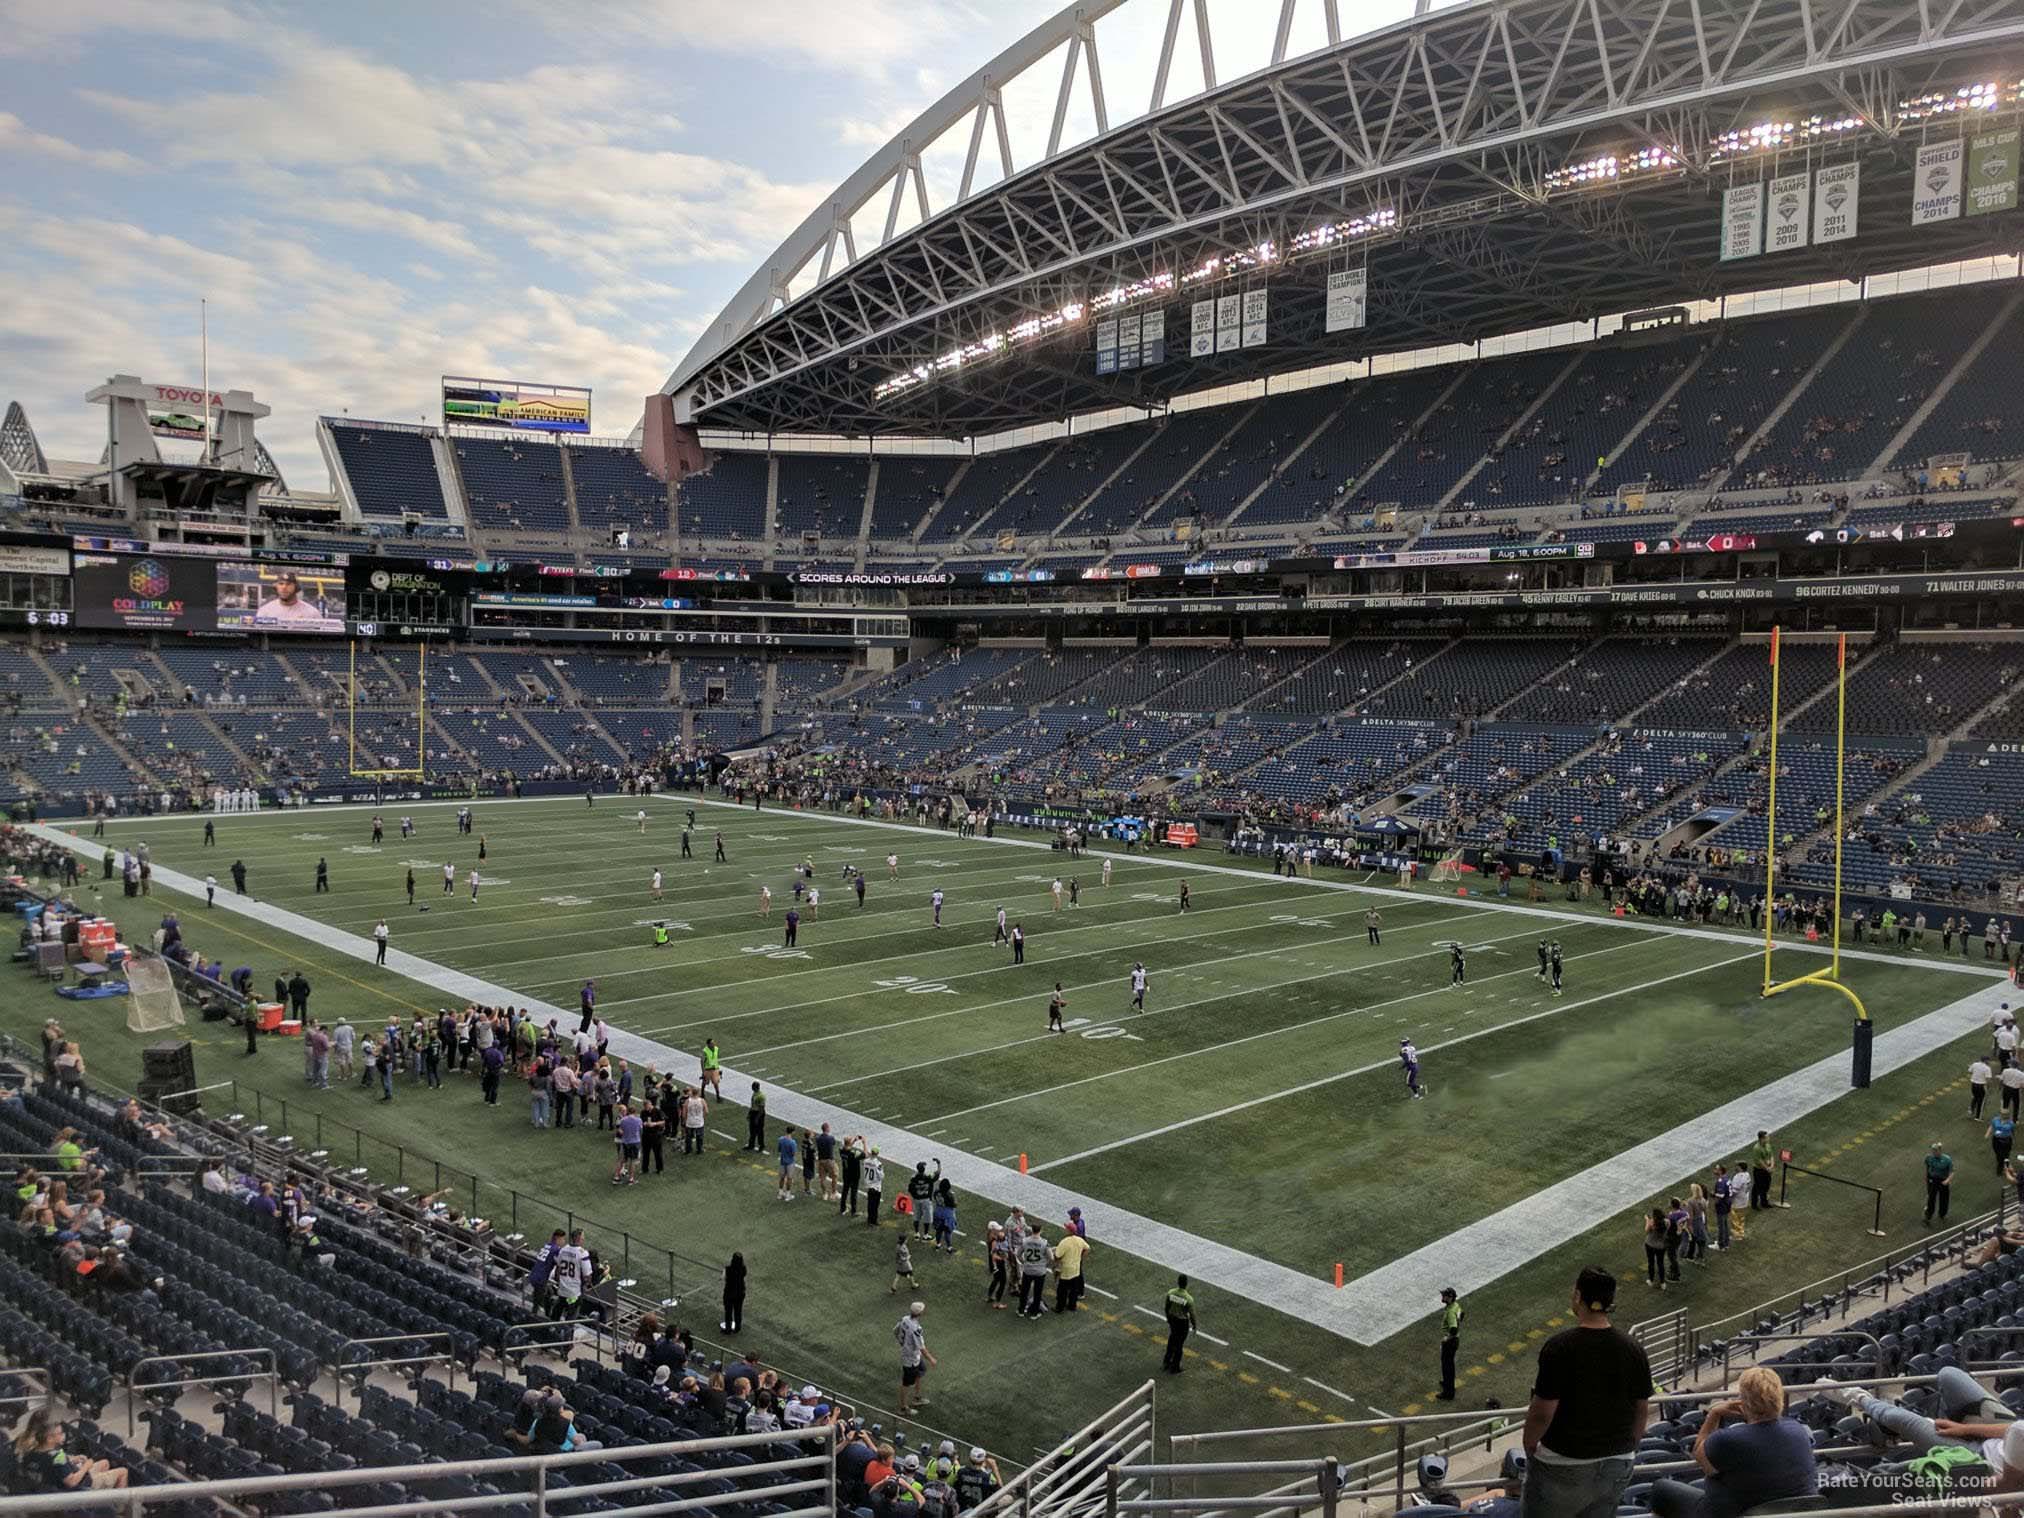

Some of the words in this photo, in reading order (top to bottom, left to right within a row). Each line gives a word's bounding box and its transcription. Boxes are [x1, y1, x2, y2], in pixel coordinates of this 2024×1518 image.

[1920, 150, 1959, 167] SHIELD
[1819, 171, 1856, 186] CHAMPS
[1772, 181, 1806, 195] CHAMPS
[1970, 181, 2015, 197] CHAMPS
[1729, 194, 1757, 205] CHAMPS
[1915, 194, 1960, 211] CHAMPS
[1923, 207, 1948, 219] 2014
[1824, 215, 1845, 226] 2011
[1776, 224, 1798, 235] 2009
[1823, 225, 1846, 237] 2014
[1776, 234, 1797, 245] 2010
[156, 386, 223, 406] TOYOTA
[520, 407, 557, 417] AMERICAN
[559, 410, 585, 418] FAMILY
[1533, 547, 1567, 556] 6:00PM
[433, 561, 448, 569] 31
[392, 573, 412, 581] DEPT
[800, 573, 843, 583] SCORES
[844, 574, 891, 584] AROUND
[892, 575, 910, 584] THE
[912, 574, 946, 583] LEAGUE
[392, 580, 441, 589] IMAGINATION
[1926, 581, 1939, 592] 71
[1940, 580, 1974, 592] WALTER
[1976, 579, 2005, 591] JONES
[1710, 589, 1734, 599] CHUCK
[1735, 588, 1755, 599] KNOX
[1796, 586, 1809, 597] 96
[1811, 585, 1841, 597] CORTEZ
[1842, 584, 1880, 596] KENNEDY
[1471, 597, 1490, 605] GREEN
[1555, 594, 1577, 603] EASLEY
[1611, 593, 1620, 601] 17
[1621, 592, 1638, 601] DAVE
[1639, 592, 1660, 601] KRIEG
[113, 598, 184, 611] COLDPLAY
[1258, 602, 1276, 610] BROWN
[1307, 600, 1319, 608] PETE
[1320, 600, 1338, 608] GROSS
[1375, 599, 1387, 607] CURT
[612, 632, 662, 641] HOME
[676, 633, 697, 642] OF
[709, 634, 742, 643] THE
[1369, 718, 1394, 726] DELTA
[1642, 729, 1675, 738] DELTA
[871, 976, 948, 993] 20
[864, 1167, 875, 1181] 70
[897, 1196, 907, 1212] G
[1026, 1248, 1041, 1263] 25
[559, 1260, 576, 1278] 28
